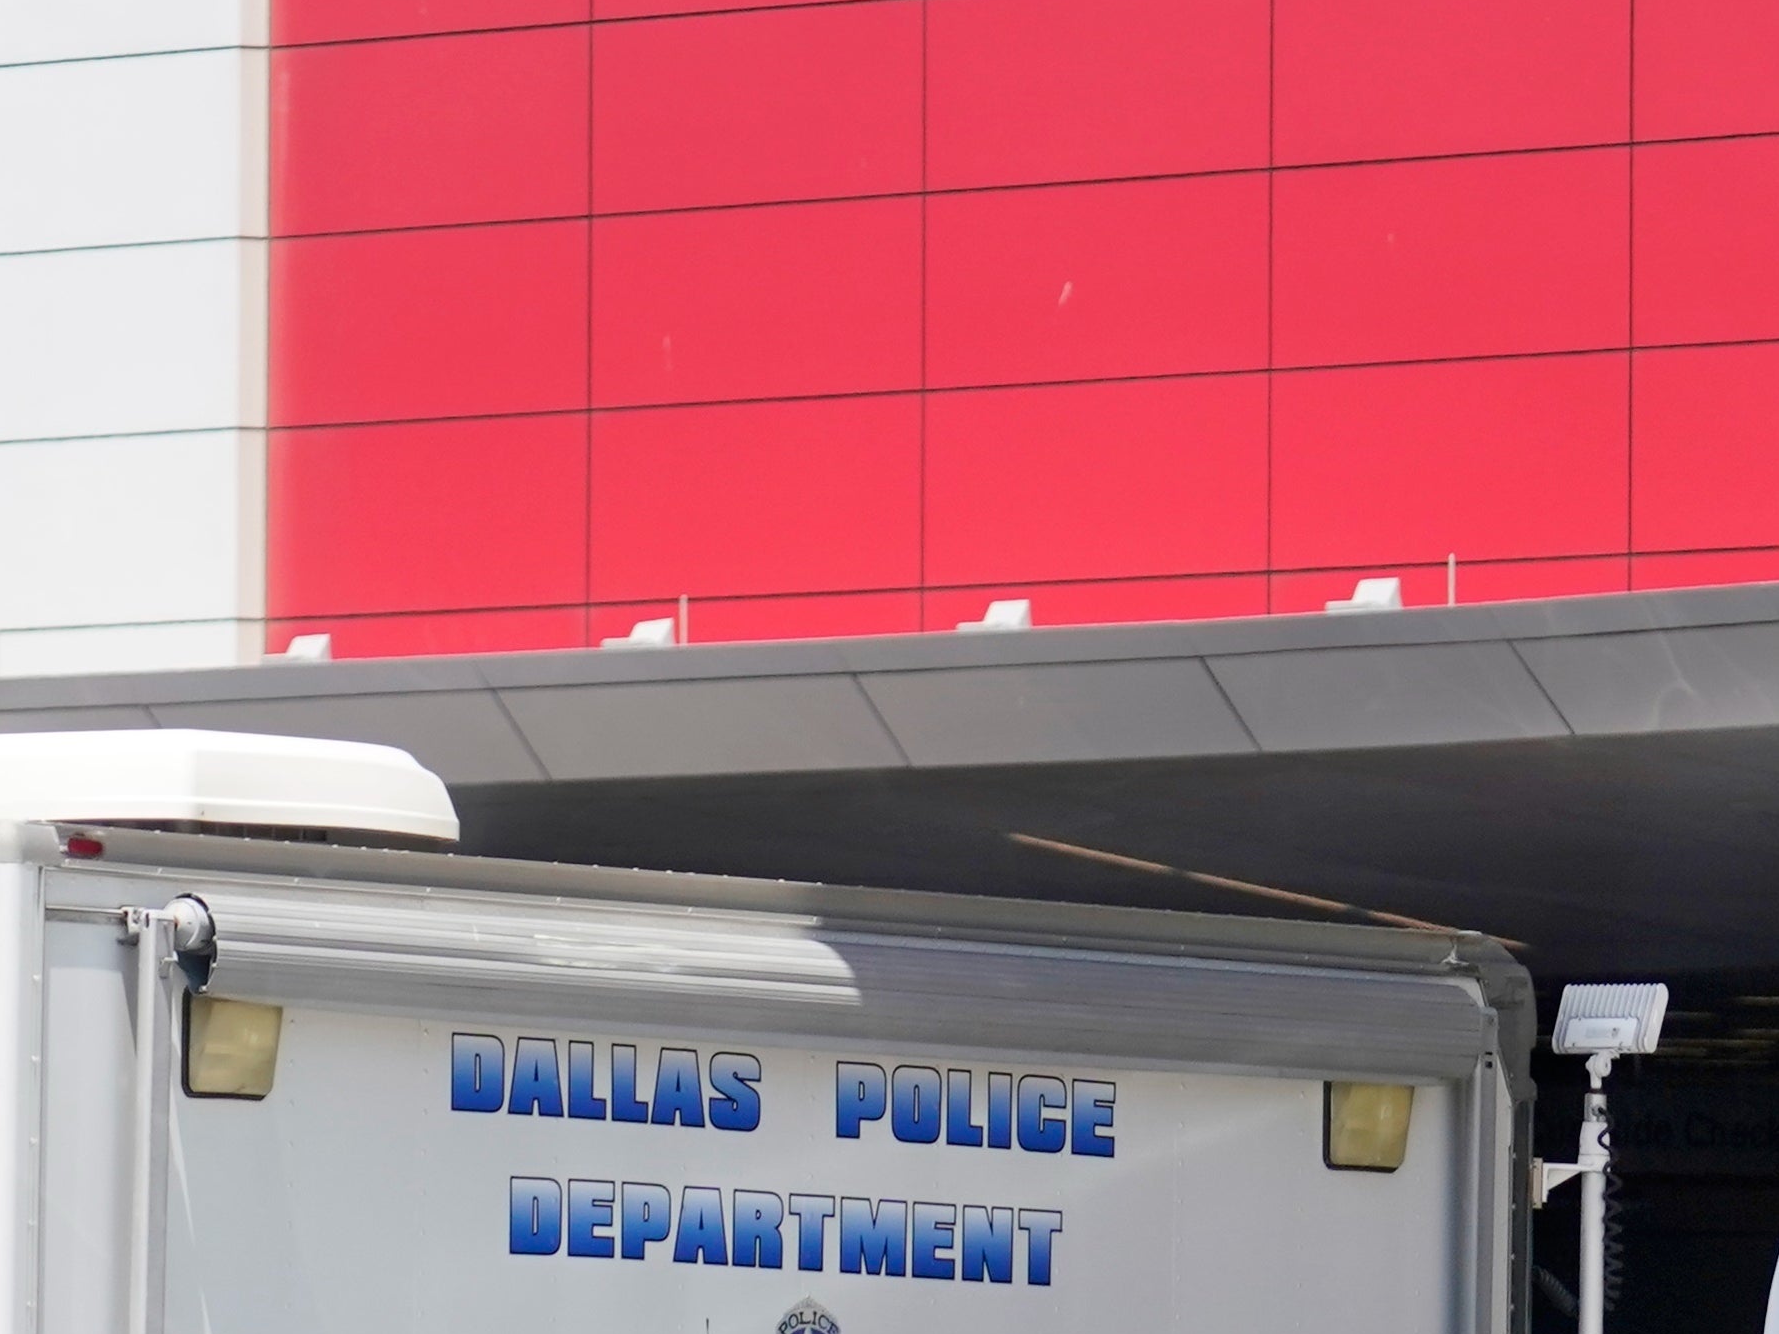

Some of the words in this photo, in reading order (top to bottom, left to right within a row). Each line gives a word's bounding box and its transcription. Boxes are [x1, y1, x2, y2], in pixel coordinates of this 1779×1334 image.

[451, 1032, 762, 1132] DALLAS
[836, 1060, 1116, 1158] POLICE
[509, 1176, 1062, 1286] DEPARTMENT
